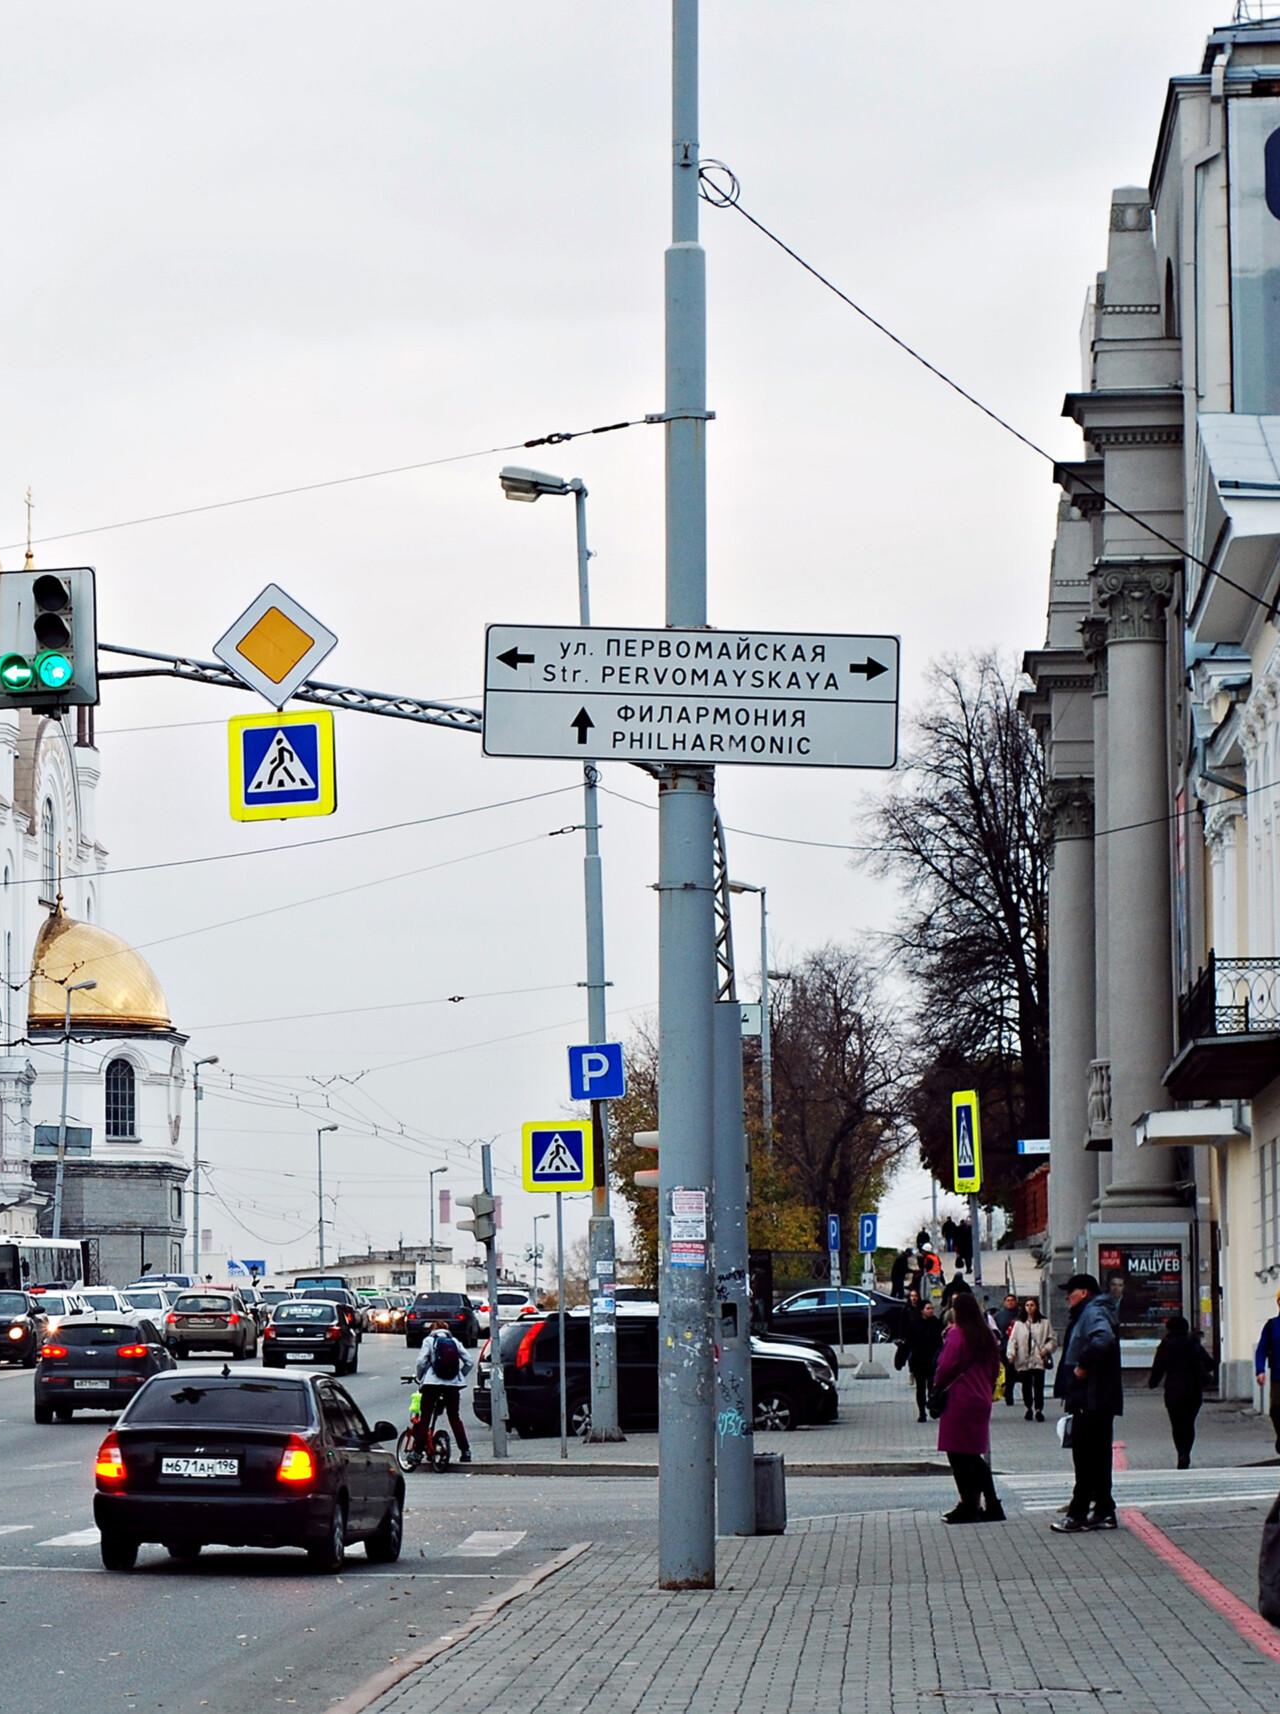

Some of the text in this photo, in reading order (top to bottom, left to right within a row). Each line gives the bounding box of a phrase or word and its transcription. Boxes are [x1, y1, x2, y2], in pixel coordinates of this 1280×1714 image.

[559, 637, 827, 663] ул. ПЕРВОМАЙСКАЯ
[542, 664, 840, 691] Str. PERVOMAYSKAYA
[616, 704, 806, 728] ФИЛАРМОНИЯ
[611, 732, 812, 755] PHILHARMONIC
[581, 1052, 610, 1092] P
[1153, 1249, 1178, 1258] ДЕНИС
[1128, 1258, 1180, 1273] МАЦУЕВ
[165, 1460, 236, 1473] М671АН 196
